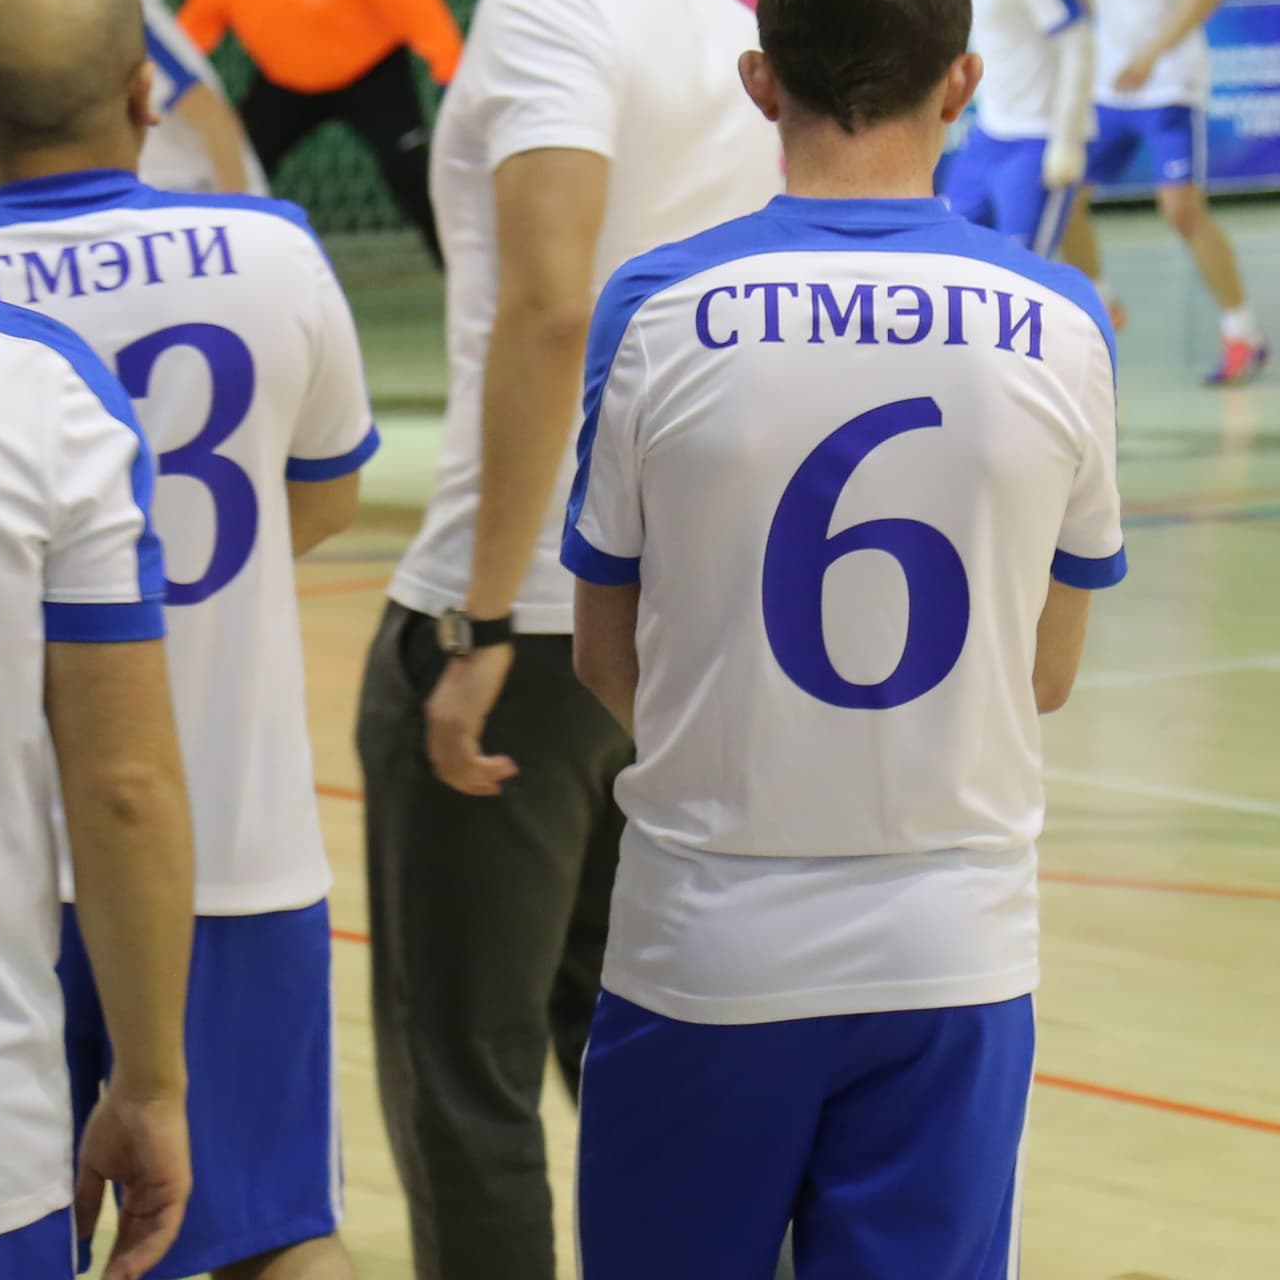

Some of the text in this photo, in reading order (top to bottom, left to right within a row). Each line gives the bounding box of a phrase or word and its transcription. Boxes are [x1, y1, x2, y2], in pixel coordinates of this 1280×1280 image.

[695, 282, 1045, 361] СТМЭГИ
[115, 322, 260, 607] 3
[761, 395, 971, 710] 6
